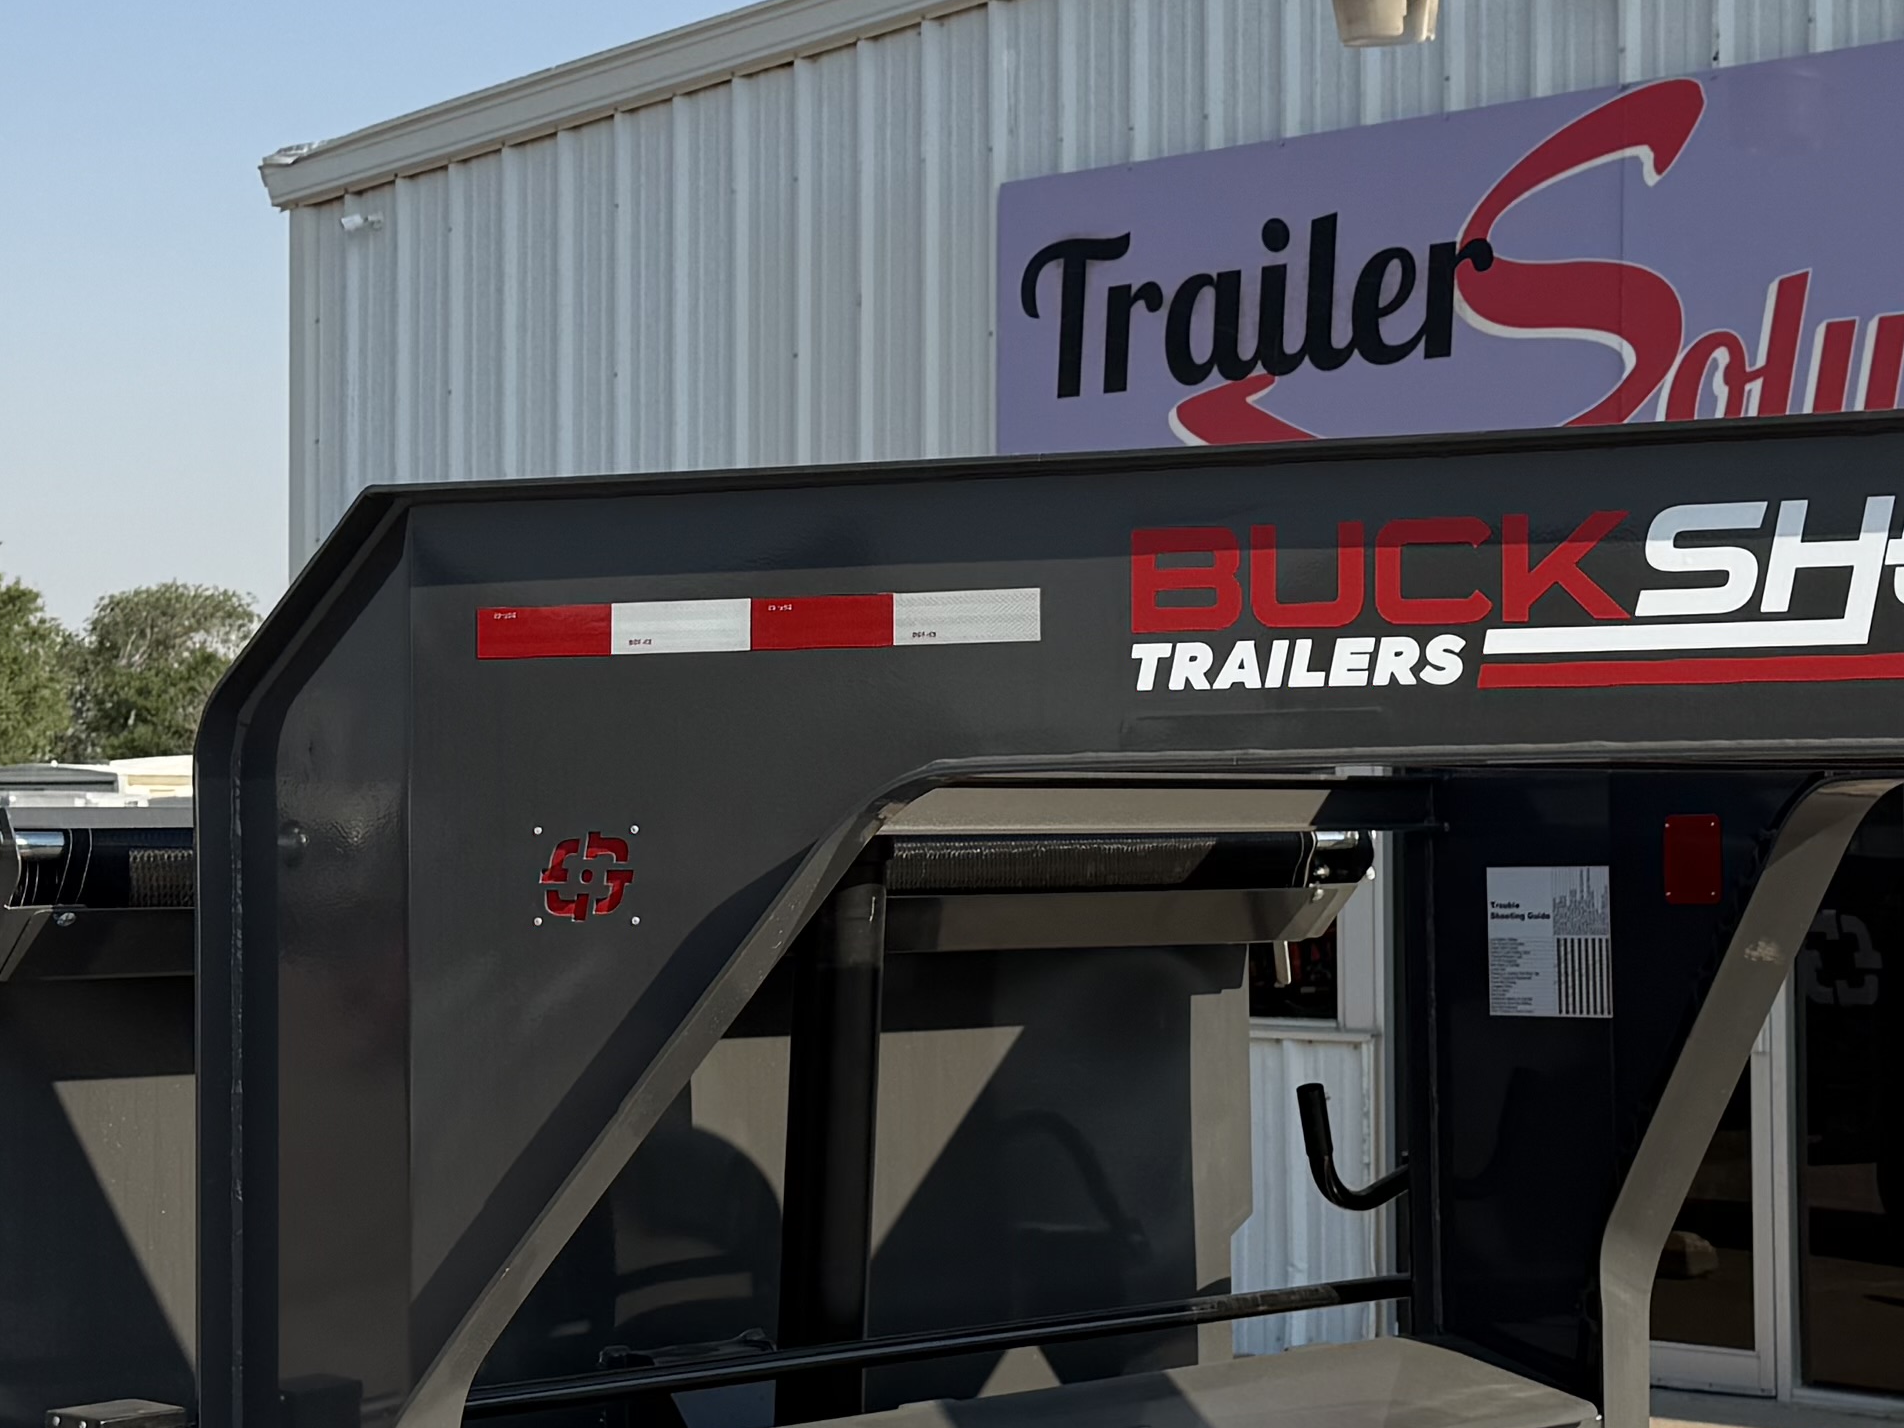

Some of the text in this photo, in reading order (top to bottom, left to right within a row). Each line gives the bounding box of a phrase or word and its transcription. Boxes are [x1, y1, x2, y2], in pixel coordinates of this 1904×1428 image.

[1020, 210, 1494, 400] Trailer
[1130, 634, 1466, 692] TRAILERS
[1527, 911, 1551, 920] Guide
